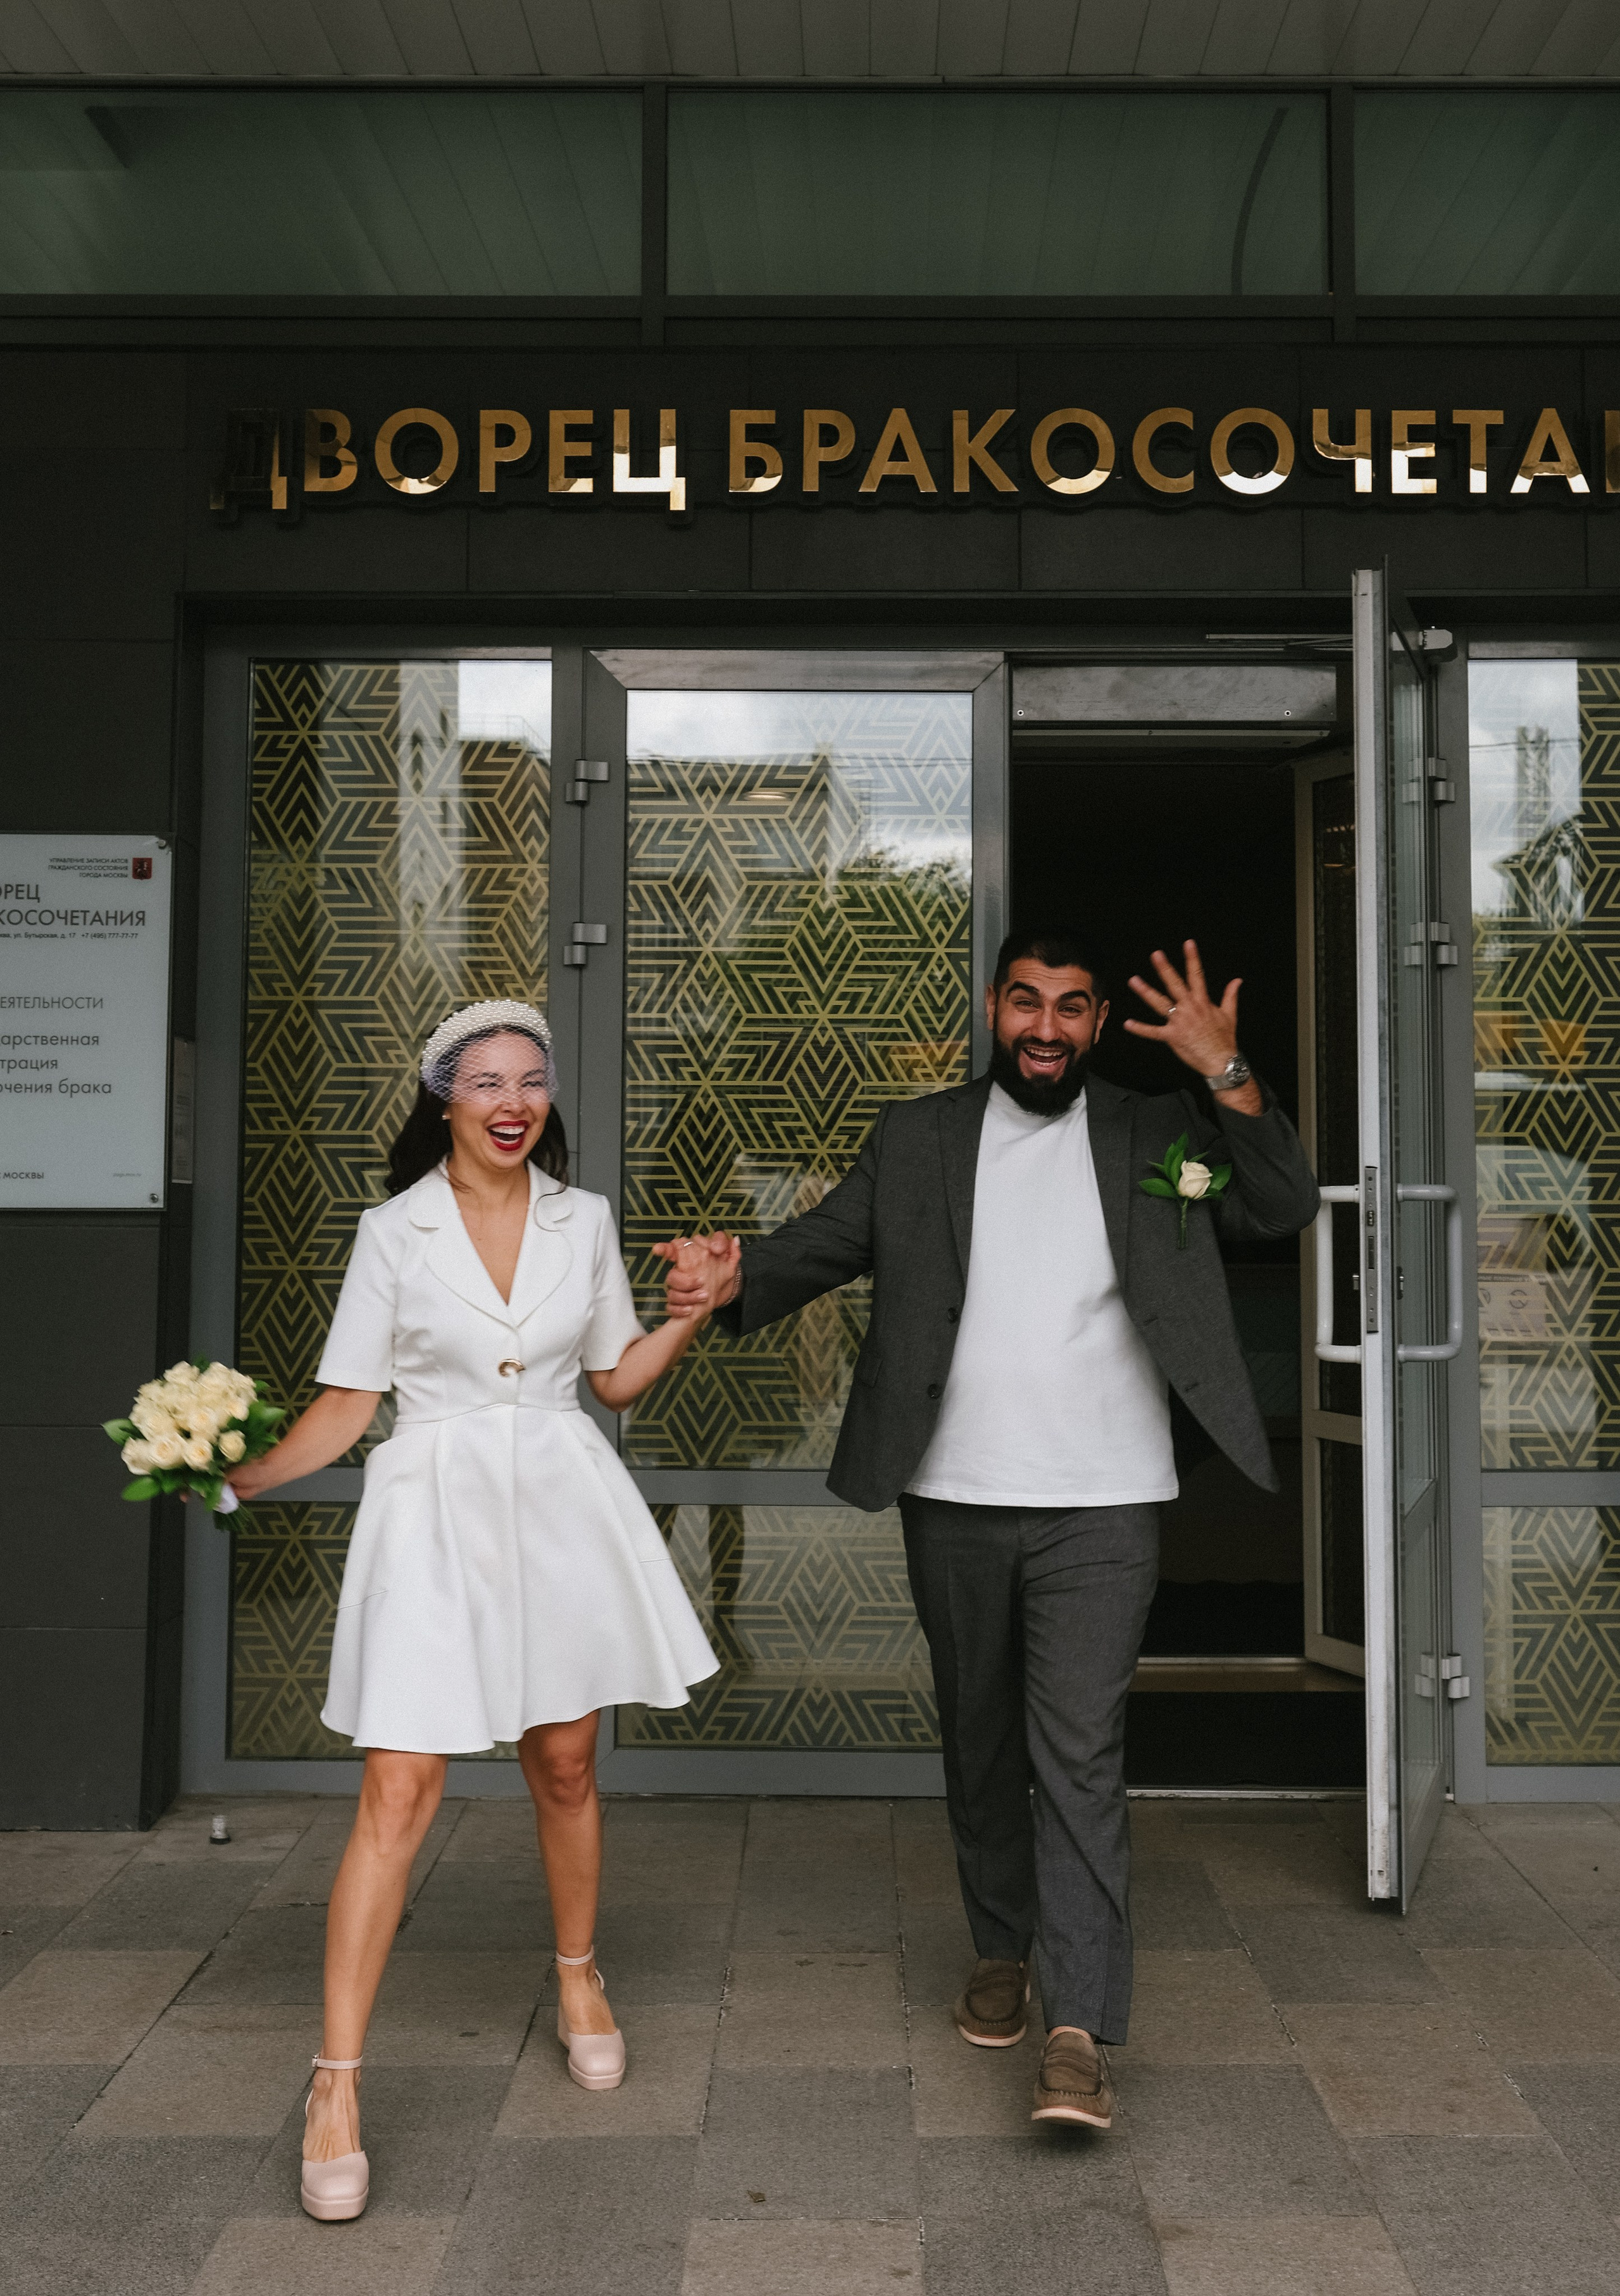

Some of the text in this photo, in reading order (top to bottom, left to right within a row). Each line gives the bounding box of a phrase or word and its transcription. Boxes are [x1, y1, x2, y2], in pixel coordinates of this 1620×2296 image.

[209, 408, 686, 510] ДВОРЕЦ
[0, 884, 40, 903] РЕЦ
[1, 1035, 99, 1049] арственная
[0, 1059, 58, 1073] трация
[59, 1078, 111, 1098] брака
